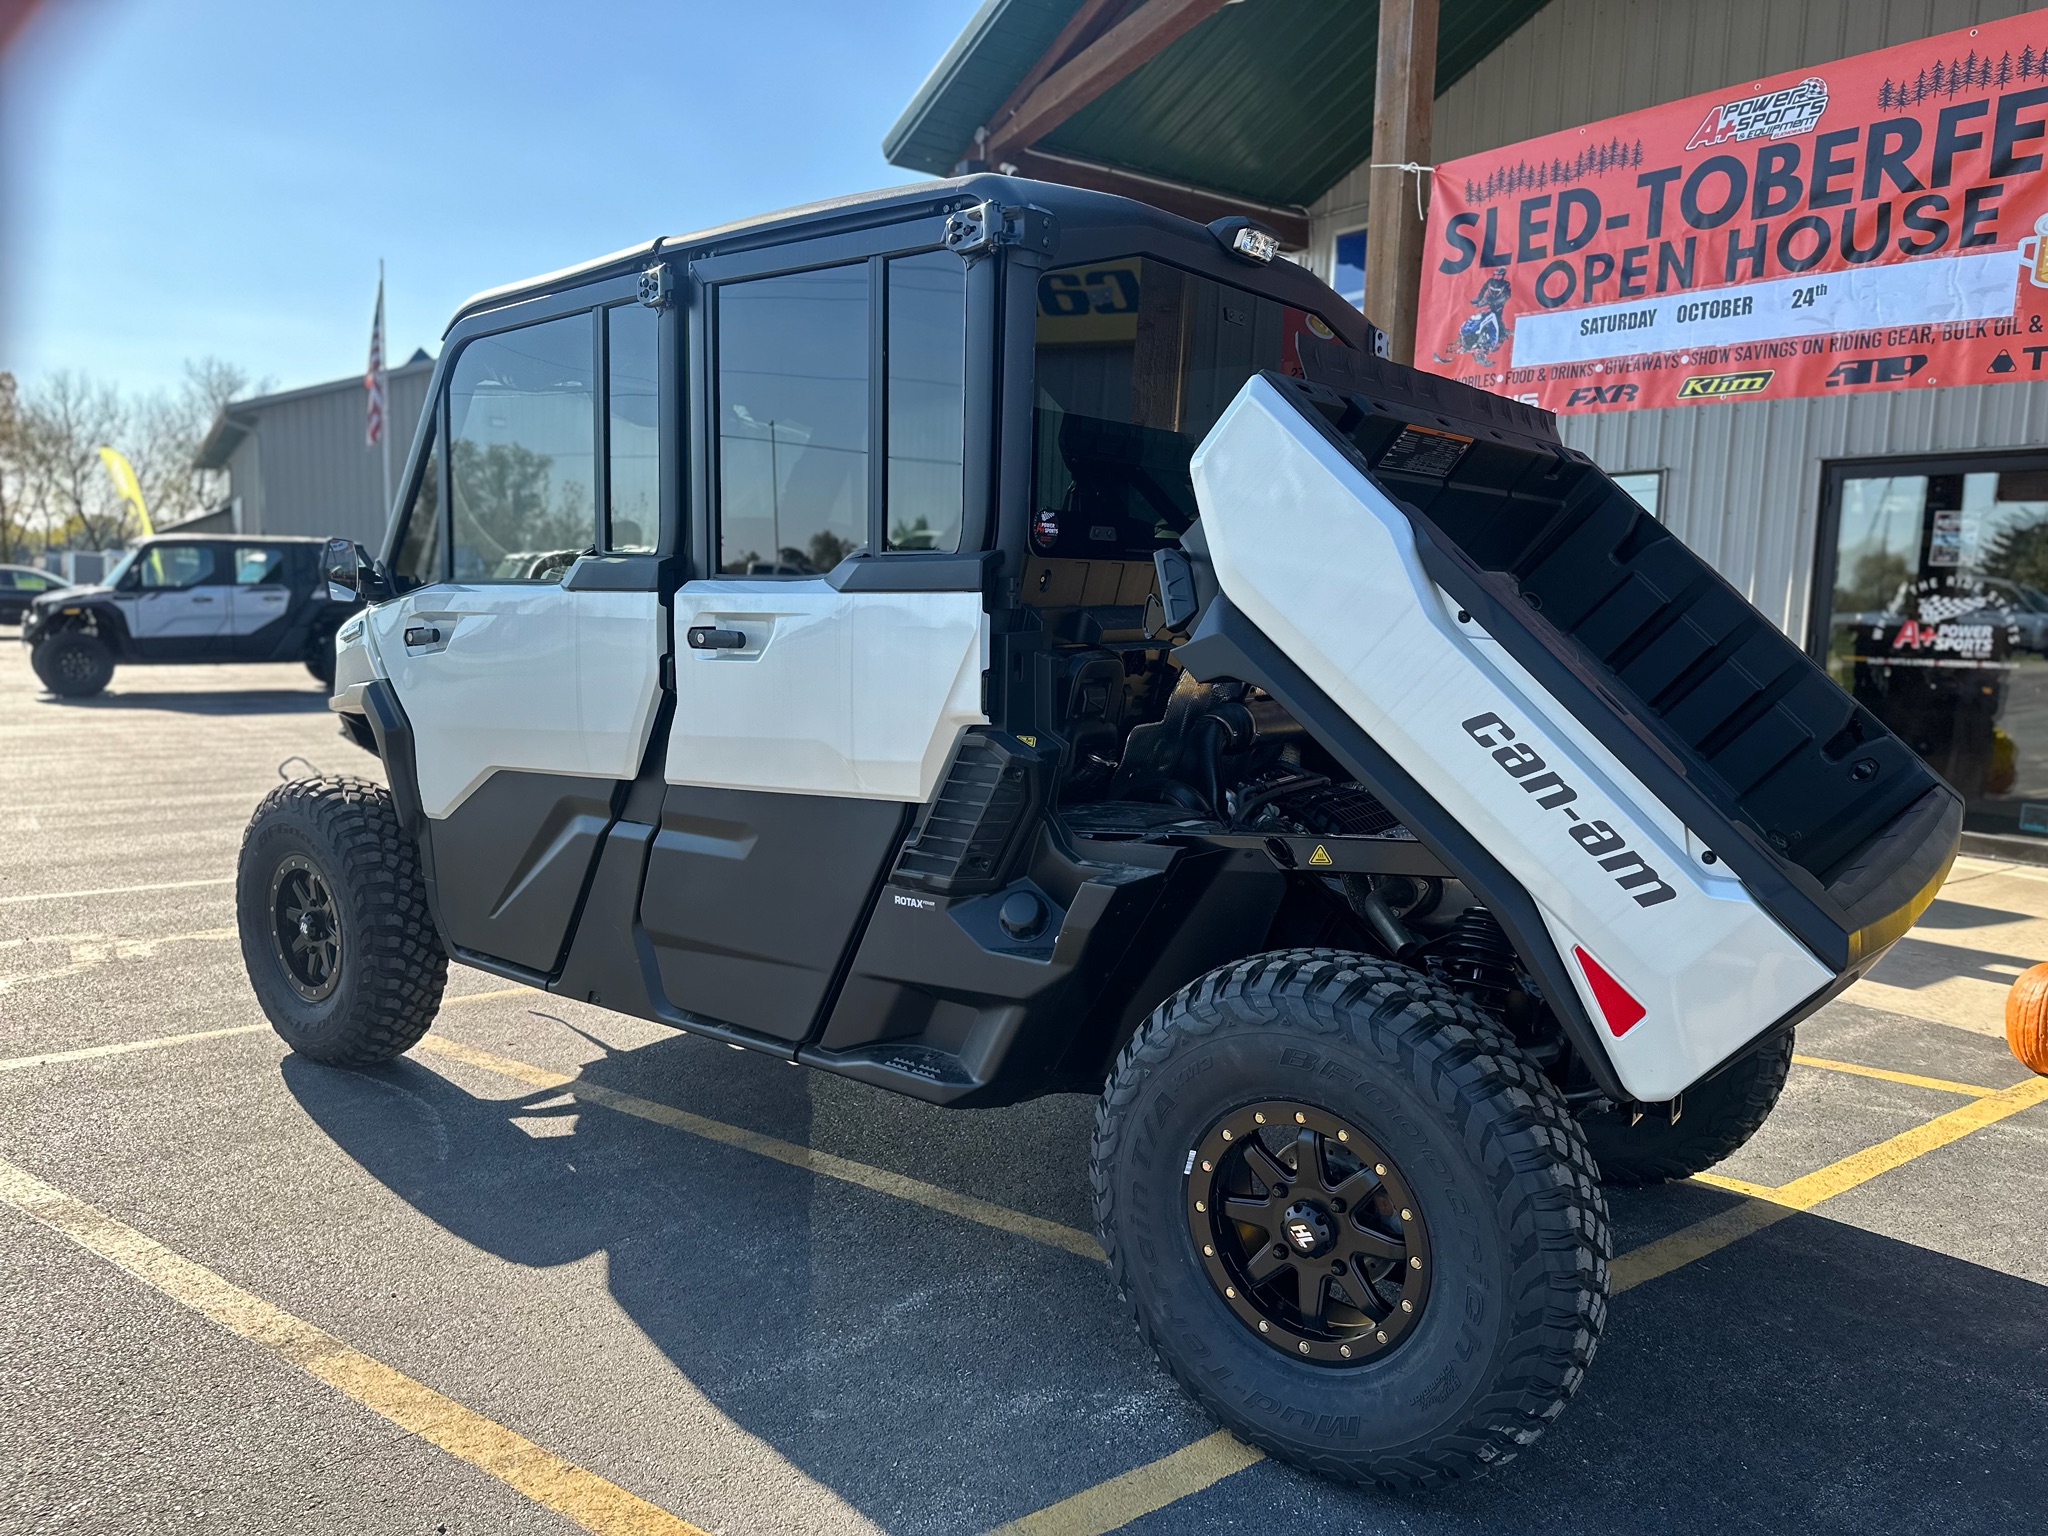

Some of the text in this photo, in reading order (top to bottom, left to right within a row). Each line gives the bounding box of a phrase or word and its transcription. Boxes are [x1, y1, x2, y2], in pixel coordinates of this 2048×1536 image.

[1535, 184, 2004, 309] OPEN HOUSE
[1580, 284, 1828, 336] SATURDAY OCTOBER 24th
[1690, 314, 2044, 366] SHOW SAVINGS ON RIDING GEAR, BULK OIL &
[1505, 362, 1594, 385] FOOD & DRINKS
[1605, 352, 1680, 375] GIVEAWAYS
[1566, 383, 1639, 407] FXR
[1893, 619, 1994, 649] A+ POWER
[1933, 638, 1994, 651] SPORTS
[1462, 711, 1677, 909] can-am
[894, 895, 923, 908] ROTAX
